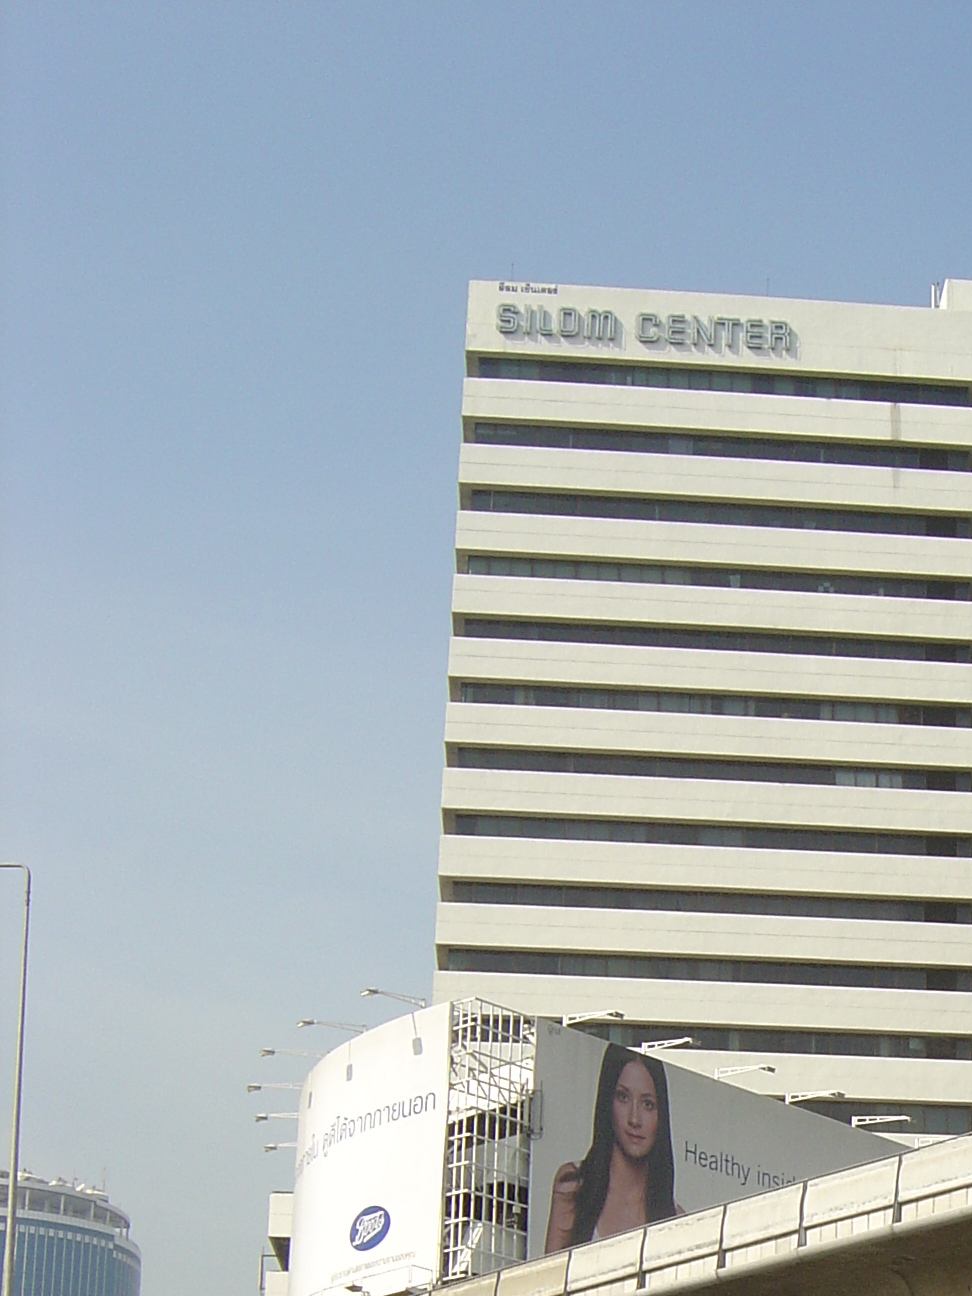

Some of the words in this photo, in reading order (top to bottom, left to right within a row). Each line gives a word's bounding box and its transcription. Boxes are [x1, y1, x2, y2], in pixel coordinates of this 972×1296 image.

[496, 303, 616, 341] SILOM
[635, 311, 791, 350] CENTER
[684, 1140, 751, 1186] Healthy
